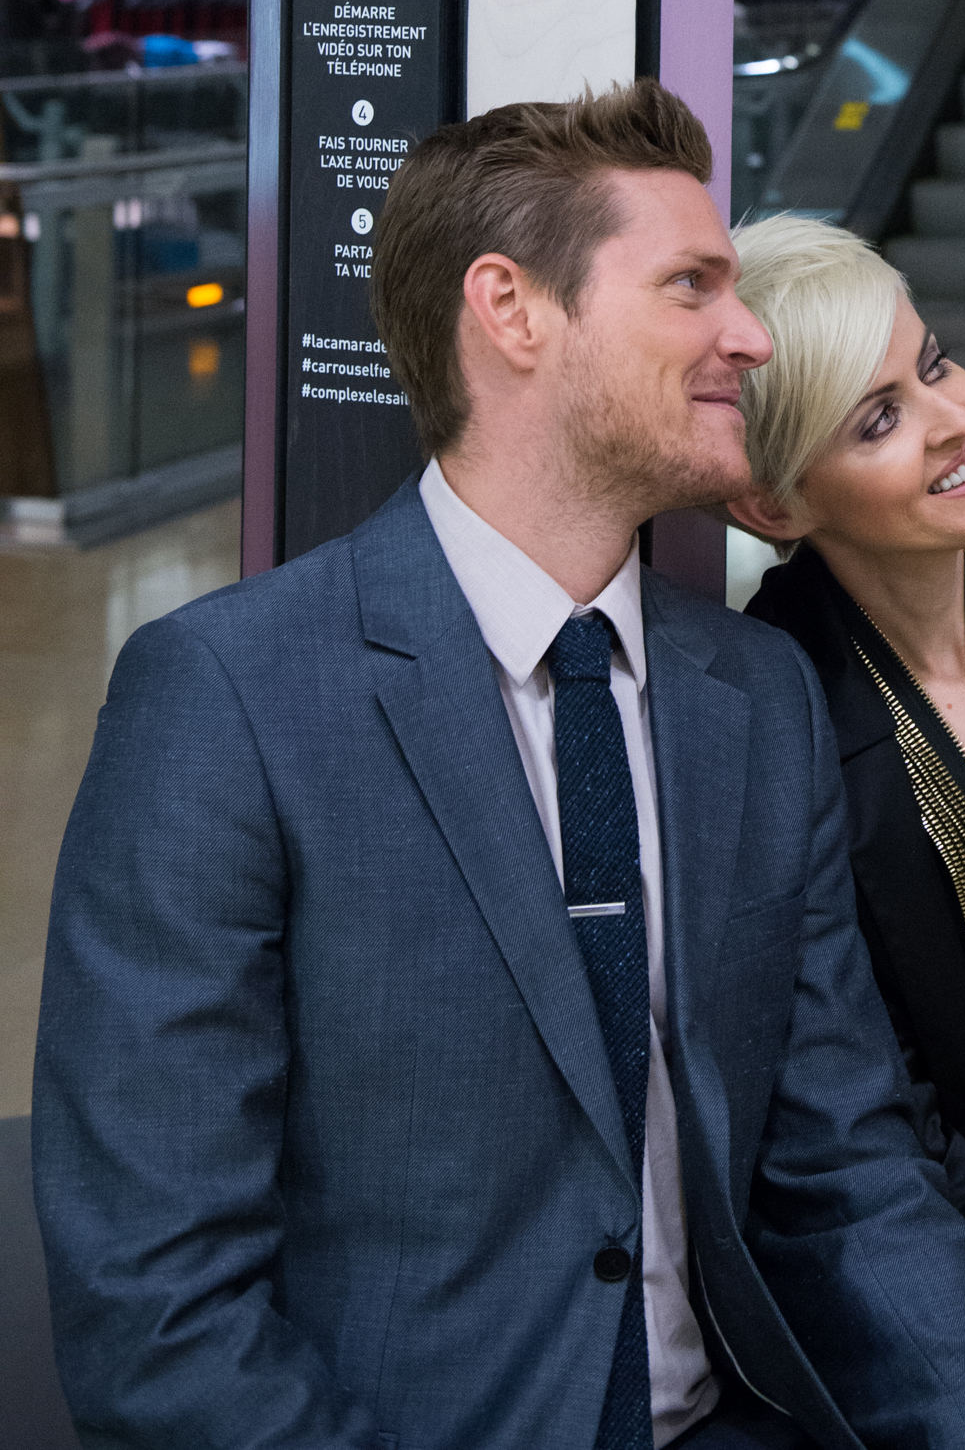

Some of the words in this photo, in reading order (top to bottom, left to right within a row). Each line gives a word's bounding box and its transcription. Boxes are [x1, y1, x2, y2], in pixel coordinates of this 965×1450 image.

[334, 3, 395, 20] DÉMARRE
[303, 23, 426, 40] L'ENREGISTREMENT
[318, 40, 354, 57] VIDÉO
[357, 44, 383, 58] SUR
[387, 45, 411, 59] TON
[327, 58, 402, 77] TÉLÉPHONE
[319, 136, 345, 150] FAIS
[349, 138, 408, 153] TOURNER
[321, 154, 352, 169] L'AXE
[337, 174, 353, 188] DE
[356, 175, 389, 190] VOUS
[335, 263, 350, 277] TA
[302, 358, 391, 378] #carrouselfie
